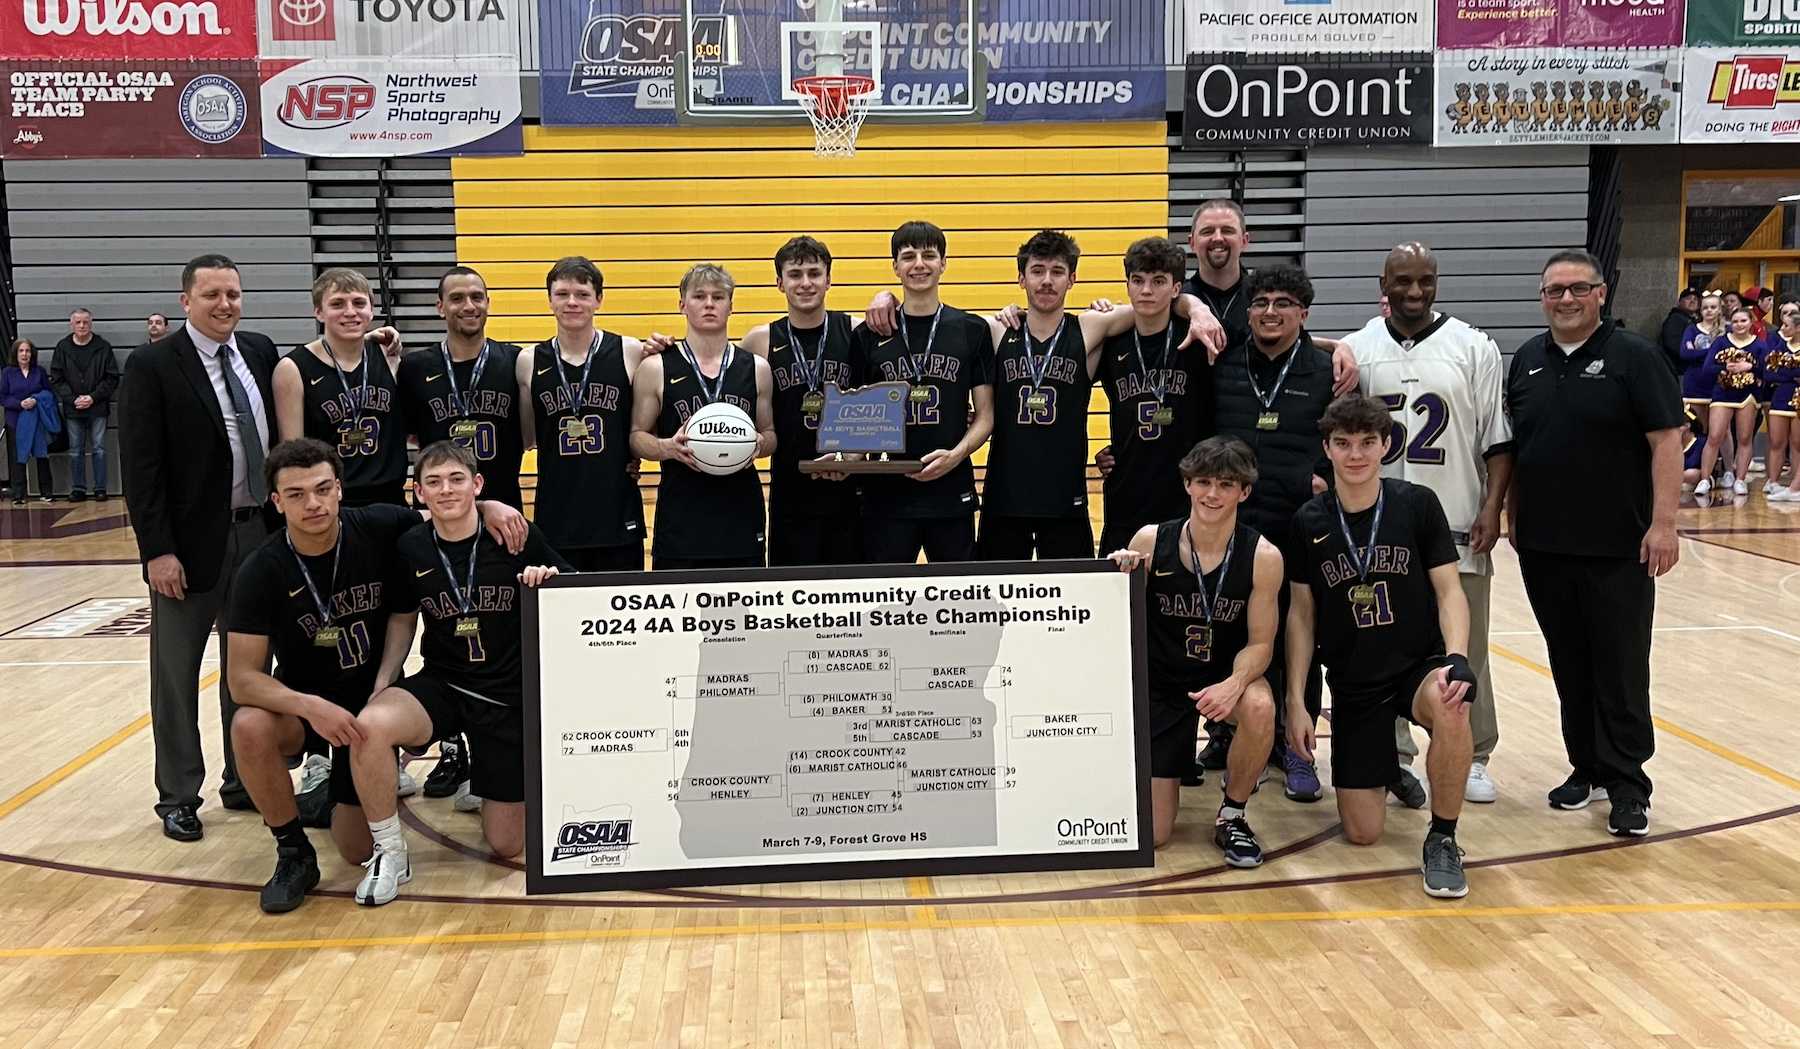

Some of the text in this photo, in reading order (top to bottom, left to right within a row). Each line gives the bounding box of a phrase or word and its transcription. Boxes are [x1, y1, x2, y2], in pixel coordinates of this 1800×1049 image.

[355, 0, 505, 22] TOYOTA
[1457, 8, 1560, 20] Experience better.
[1629, 8, 1665, 17] HEALTH
[1199, 12, 1417, 25] PACIFIC OFFICE AUTOMATION
[583, 17, 724, 63] OSAA
[796, 20, 1111, 46] OPOINT COMMUNITY
[1252, 33, 1376, 42] PROBLEM SOLVED
[796, 48, 907, 71] CEDIT
[1468, 55, 1631, 76] A story in every stitch
[582, 65, 719, 76] STATE CHAMPIOHIPS
[10, 72, 174, 87] OFFICIAL OSAA
[192, 78, 222, 90] SCHOOL
[386, 73, 478, 87] Northwest
[1733, 63, 1779, 95] Tires
[11, 87, 155, 102] TEAM PARTY
[386, 90, 446, 104] Sports
[1197, 64, 1412, 118] OnPoint
[198, 99, 226, 115] OSAA
[282, 84, 376, 121] NSP
[12, 103, 84, 117] PLACE
[387, 106, 501, 125] Photography
[189, 124, 239, 141] ASSOCIATION
[1195, 126, 1411, 140] COMMUNITY CREDIT UNION
[1705, 122, 1745, 132] DOING
[1749, 122, 1769, 132] THE
[13, 130, 44, 144] Abby's
[350, 131, 433, 142] www.4nsp.com
[880, 354, 960, 383] BAKER
[1116, 369, 1187, 401] BAKER
[428, 390, 511, 423] BAKER
[1017, 385, 1057, 425] 13
[1138, 401, 1162, 440] 5
[558, 413, 604, 456] 23
[699, 422, 747, 437] Wilson
[611, 583, 1062, 611] OSAA / OnPoint Community Credit Union
[580, 604, 1091, 636] 2024 4A Boys Basketball State Championship
[816, 632, 863, 640] Quarterfinals
[1185, 624, 1212, 662] 2
[337, 620, 371, 669] 11
[828, 649, 869, 659] MADRAS
[878, 649, 889, 658] 36
[807, 662, 889, 673] (1) CASCADE 62
[933, 666, 1012, 677] BAKER 74
[665, 674, 749, 686] 47 MADRAS
[928, 679, 1012, 689] CASCADE 54
[666, 687, 755, 698] 41 PHILOMATH
[822, 693, 877, 703] PHILOMATH
[812, 705, 865, 717] (4) BAKER
[853, 717, 982, 731] 3rd MARIST CATHOLIC 63
[1044, 715, 1078, 724] BAKER
[563, 729, 689, 741] 62 CROOK COUNTY 6th
[853, 730, 982, 743] 5th CASCADE 53
[1026, 727, 1098, 737] JUNCTION CITY
[563, 739, 689, 756] 72 MADRAS 4th
[790, 748, 906, 761] (14) CROOK COUNTY 42
[809, 763, 845, 773] MARIST
[848, 761, 895, 771] CATHOLIC
[911, 767, 996, 778] MARIST CATHOLIC
[691, 776, 770, 787] CROOK COUNTY
[916, 780, 1017, 792] JUNCTION CITY 57
[710, 790, 750, 800] HENLEY
[812, 791, 870, 803] (7) HENLEY
[796, 804, 888, 817] (2) JUNCTION CITY
[558, 821, 631, 847] OSAA
[1057, 818, 1128, 837] OnPoint
[763, 832, 927, 848] March 7-9, Forest Grove HS
[590, 855, 621, 863] OnPoint
